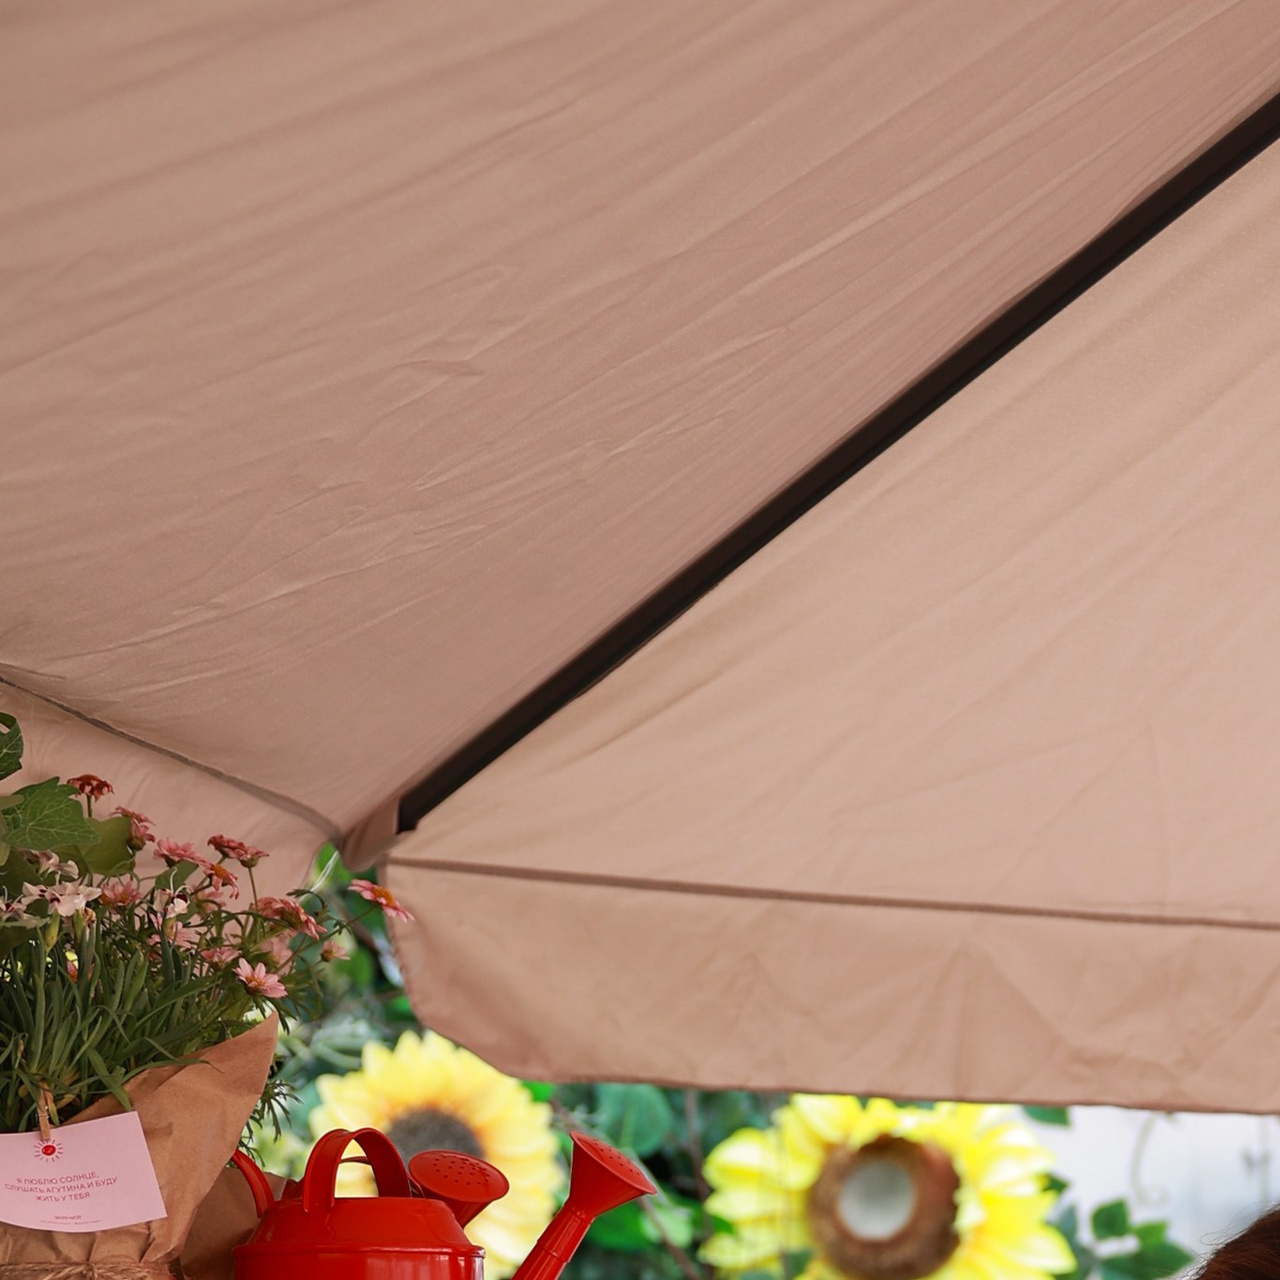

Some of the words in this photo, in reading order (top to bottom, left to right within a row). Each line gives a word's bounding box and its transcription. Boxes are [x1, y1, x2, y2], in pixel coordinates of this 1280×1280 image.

[4, 1183, 45, 1194] СЛУШАТЬ
[46, 1183, 86, 1193] АГУТИНА
[95, 1177, 118, 1187] БУДУ
[24, 1177, 58, 1185] ЛЮБЛЮ
[68, 1192, 91, 1201] ТЕБЯ
